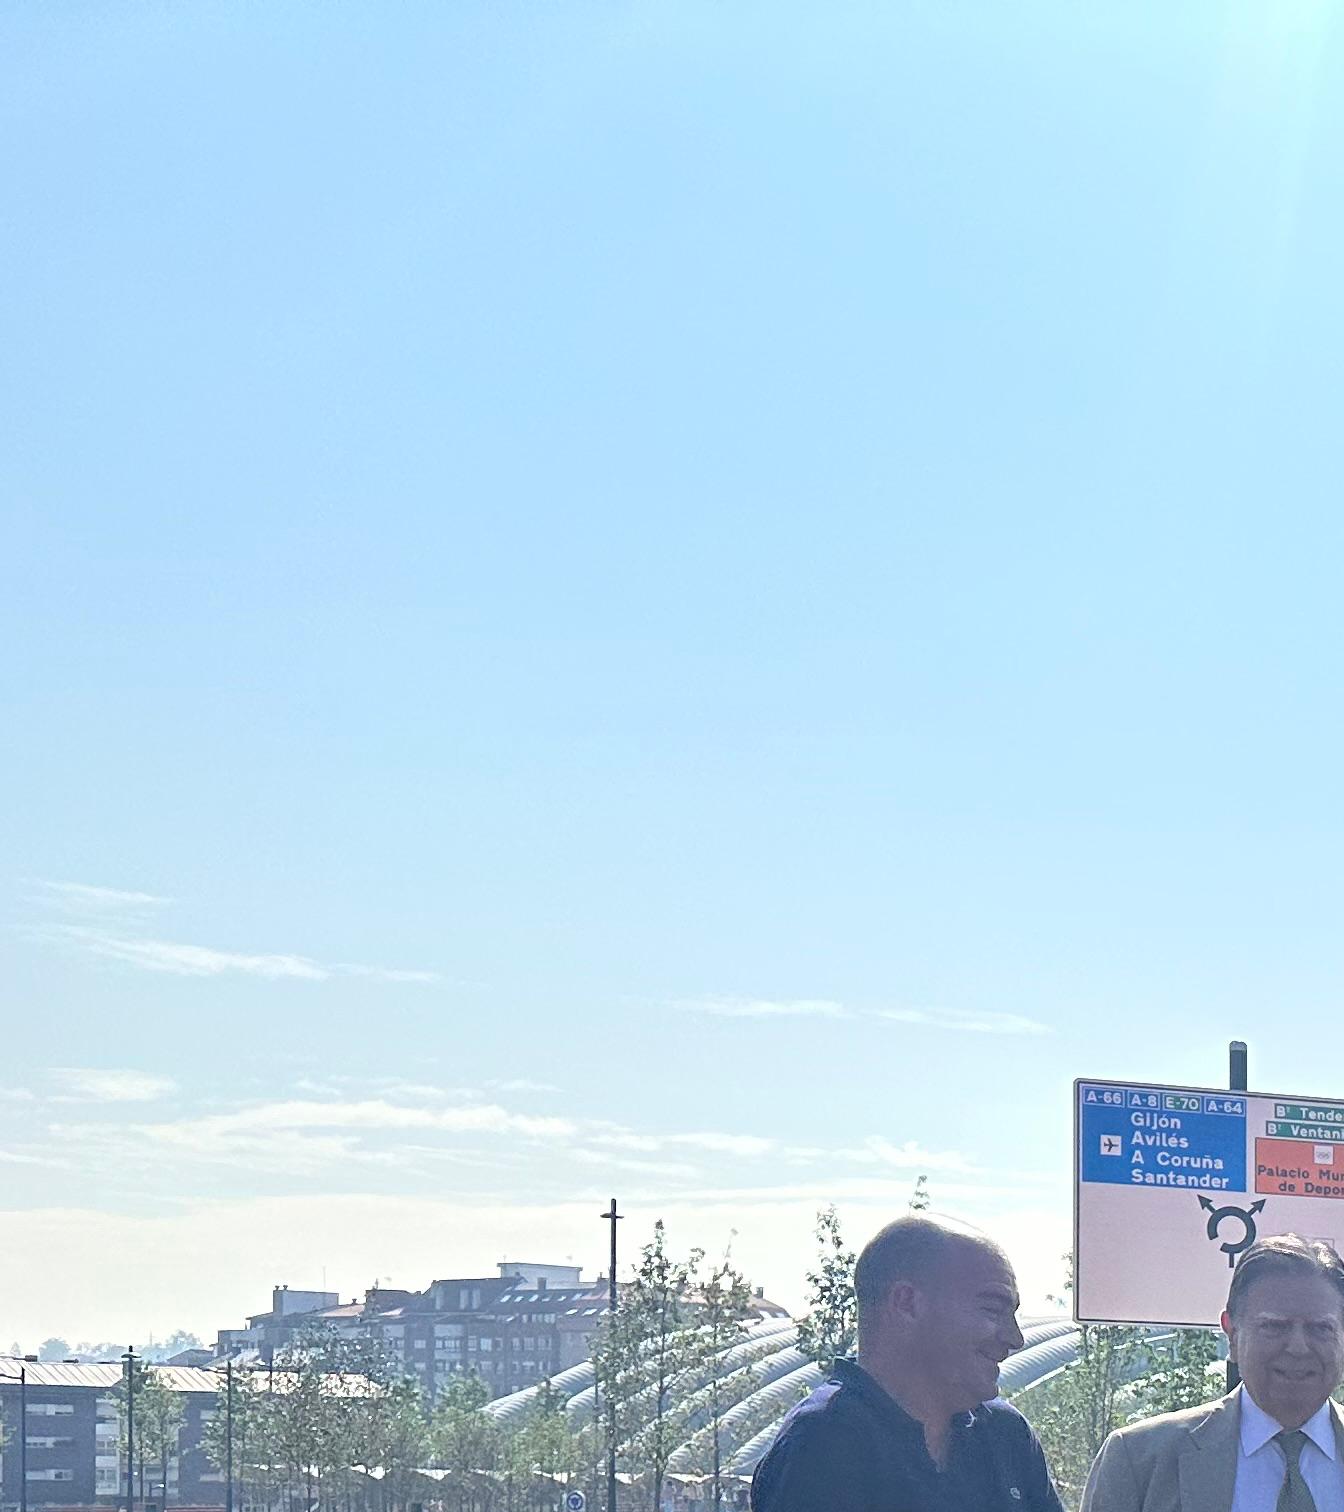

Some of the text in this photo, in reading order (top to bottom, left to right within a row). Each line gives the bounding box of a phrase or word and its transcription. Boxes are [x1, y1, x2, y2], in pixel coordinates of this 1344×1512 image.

[1086, 1091, 1122, 1104] A-66
[1131, 1094, 1157, 1107] A-8
[1165, 1096, 1199, 1110] E-70
[1207, 1100, 1243, 1114] A-64
[1130, 1111, 1181, 1130] Gijón
[1131, 1130, 1189, 1148] Avilés
[1131, 1150, 1224, 1170] A Coruña
[1131, 1168, 1230, 1189] Santander
[1257, 1165, 1310, 1179] Palacio
[1278, 1181, 1296, 1192] de
